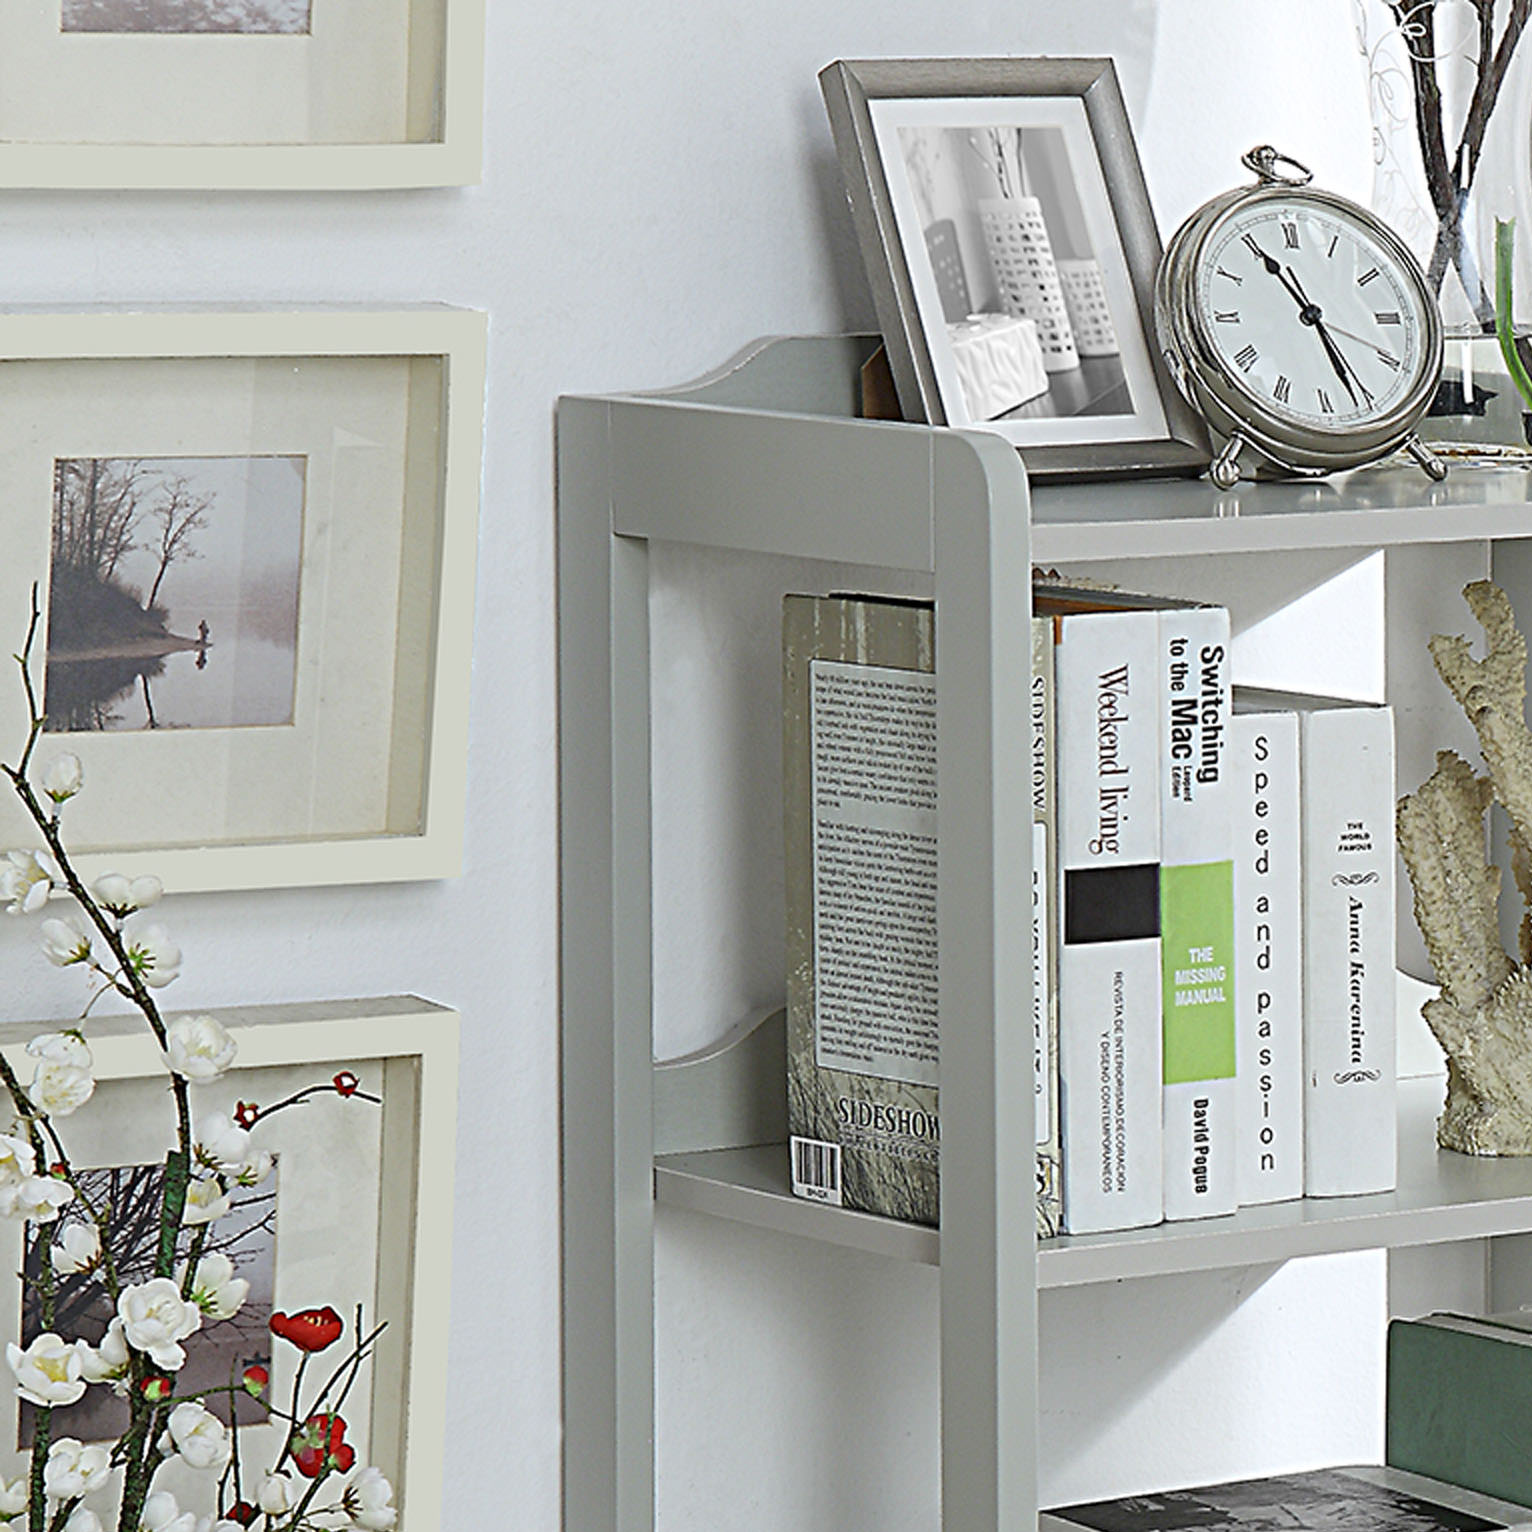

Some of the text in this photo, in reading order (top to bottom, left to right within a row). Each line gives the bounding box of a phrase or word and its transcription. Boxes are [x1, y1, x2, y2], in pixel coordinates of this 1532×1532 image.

[1170, 637, 1199, 760] to the Mac
[1197, 645, 1225, 785] Switching
[1088, 663, 1130, 855] Weekend living
[1347, 822, 1363, 831] THE
[1174, 966, 1226, 986] MISSING
[1174, 986, 1227, 1007] MANUAL
[1188, 945, 1215, 964] THE
[1254, 735, 1275, 1171] Speed and passion
[1350, 894, 1365, 1064] Anna Karenina
[838, 1097, 940, 1141] SIDESHOW
[1192, 1098, 1210, 1194] David Pogue
